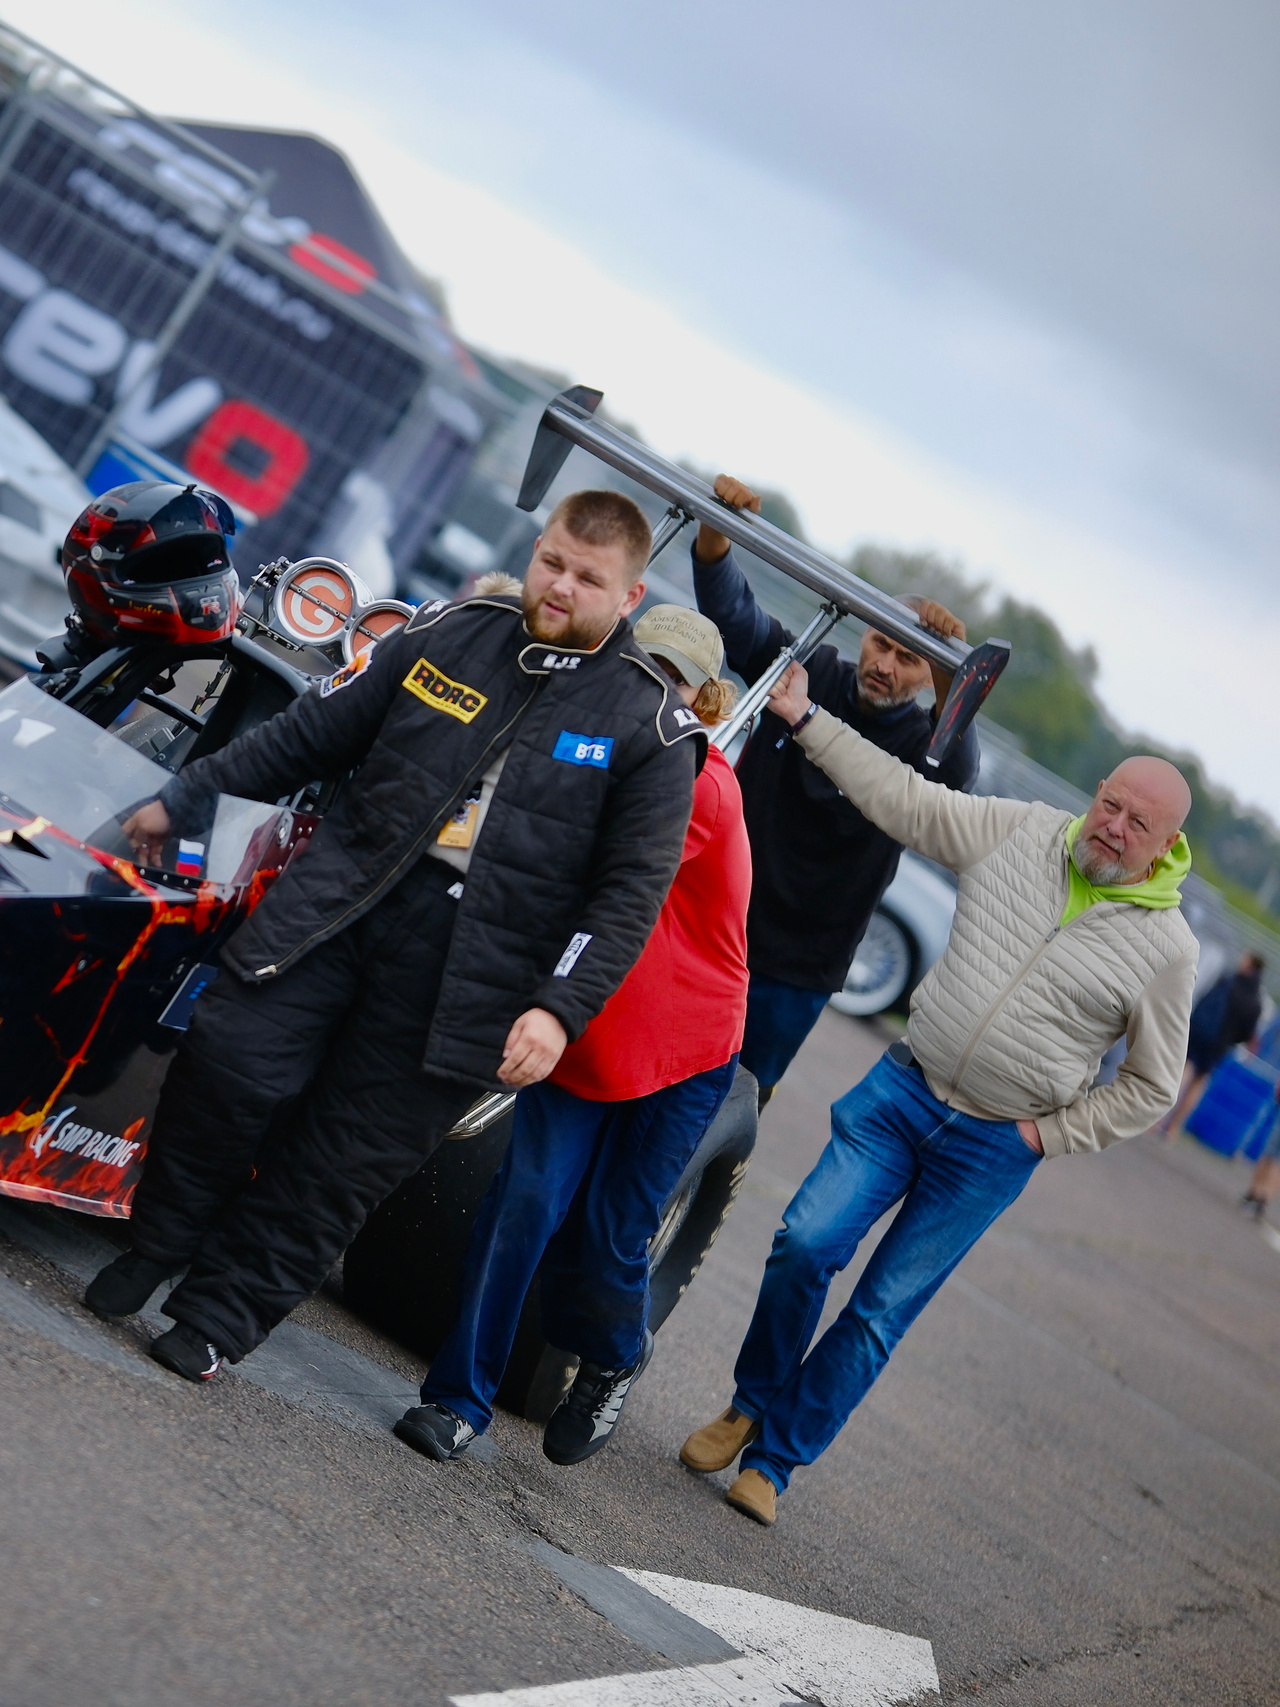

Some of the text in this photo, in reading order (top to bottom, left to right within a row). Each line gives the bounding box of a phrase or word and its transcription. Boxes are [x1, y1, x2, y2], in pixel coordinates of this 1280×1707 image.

[650, 616, 707, 640] AMSTERDAM
[653, 624, 697, 644] HOLLAND
[411, 664, 481, 713] RDRC
[49, 1122, 140, 1168] SMP RACING
